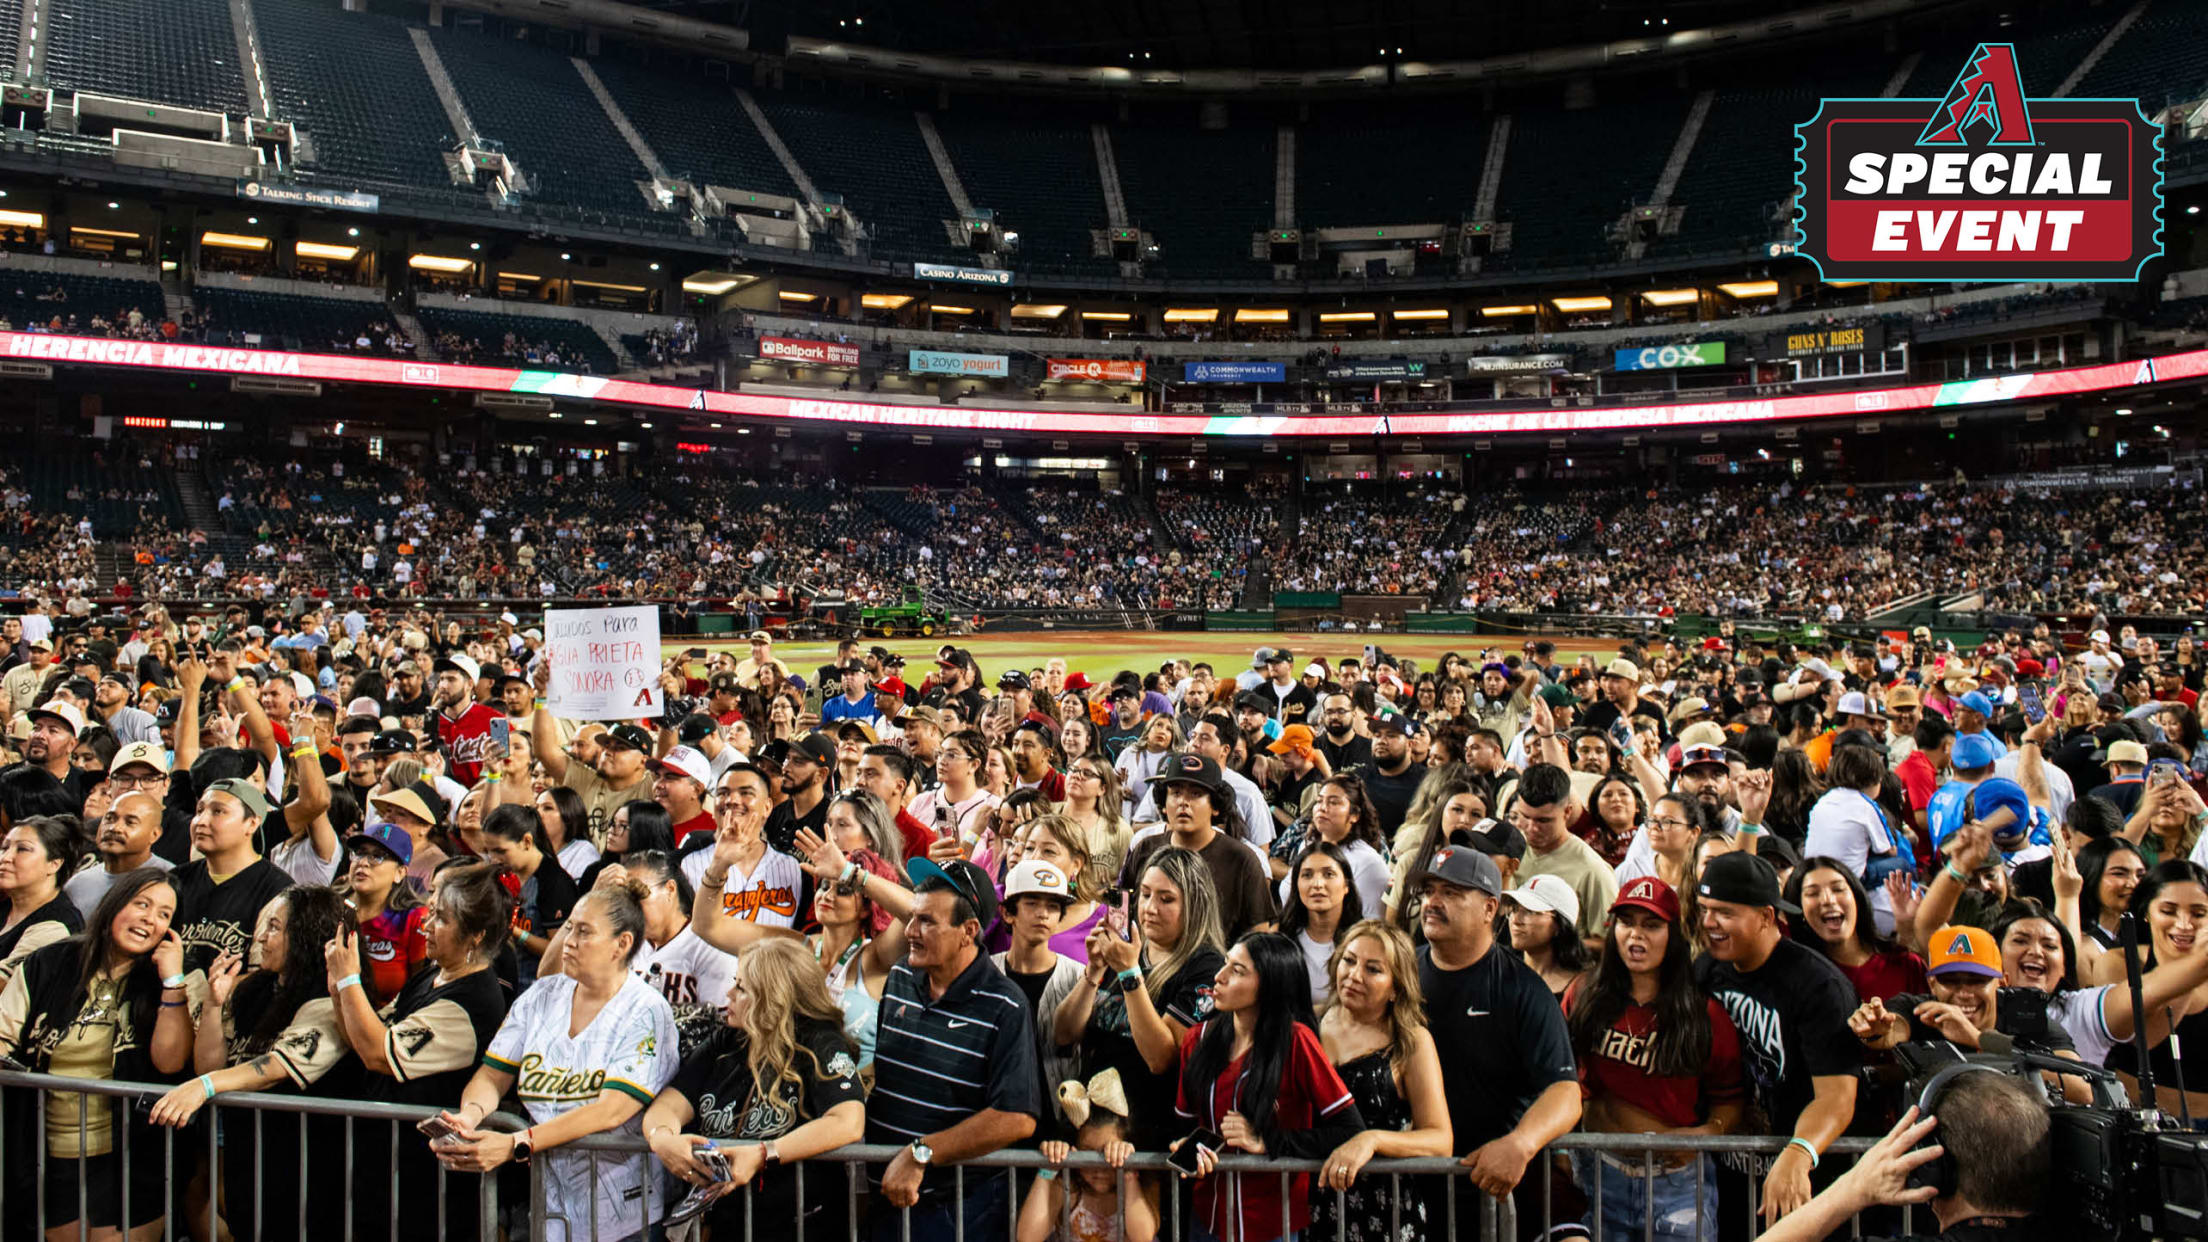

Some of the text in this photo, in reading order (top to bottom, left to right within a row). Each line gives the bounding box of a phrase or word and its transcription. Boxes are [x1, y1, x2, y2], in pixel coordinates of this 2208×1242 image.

[775, 342, 824, 359] Ballpark
[1787, 333, 1815, 351] GUNS
[1830, 328, 1864, 346] ROSES
[9, 335, 301, 375] HERENCIA MEXICANA
[827, 352, 859, 364] FOR FREE
[932, 357, 1001, 372] zoyo yogurt
[1639, 344, 1705, 369] COX
[1050, 363, 1088, 375] CIRCLE
[1210, 366, 1277, 374] COMMONWEALTH
[788, 399, 1037, 429] MEXICAN HERITAGE NIGHT
[1448, 400, 1776, 433] NOCHE DE LA HERENCIA MEXICANA
[588, 640, 643, 664] PRIETA
